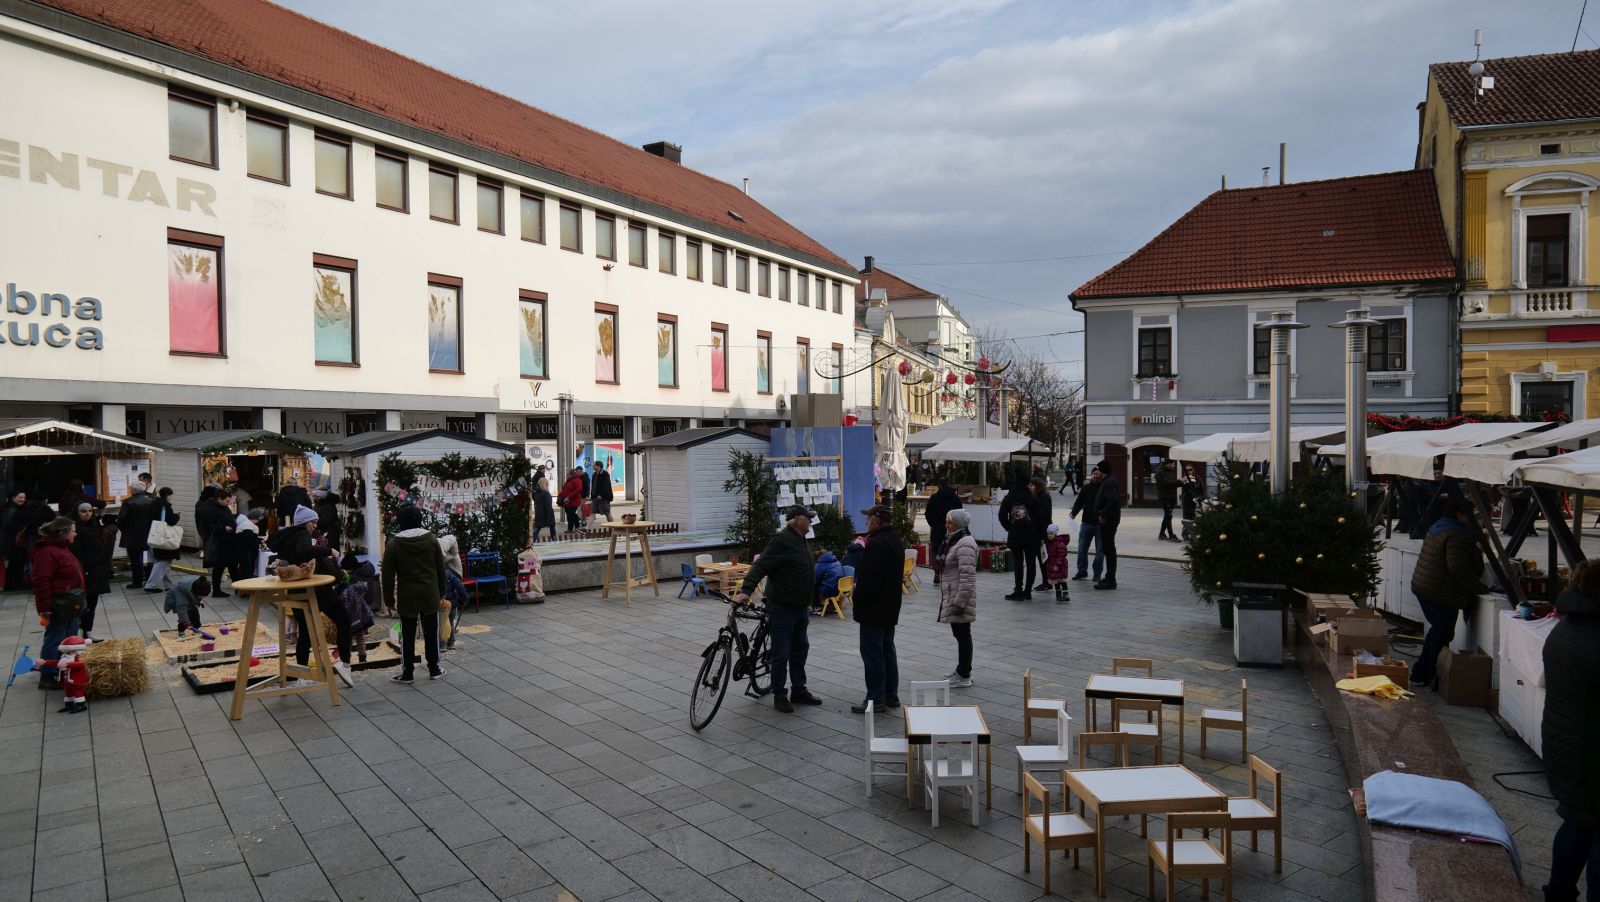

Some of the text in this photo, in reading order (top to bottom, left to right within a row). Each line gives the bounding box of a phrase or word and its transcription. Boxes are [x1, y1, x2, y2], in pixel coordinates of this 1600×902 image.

[0, 282, 103, 321] bna
[528, 400, 548, 409] YUKI
[168, 416, 215, 434] YUKI
[1141, 413, 1178, 424] mlinar
[302, 419, 340, 434] YUKI
[454, 420, 476, 433] YUK
[576, 424, 591, 434] UKI
